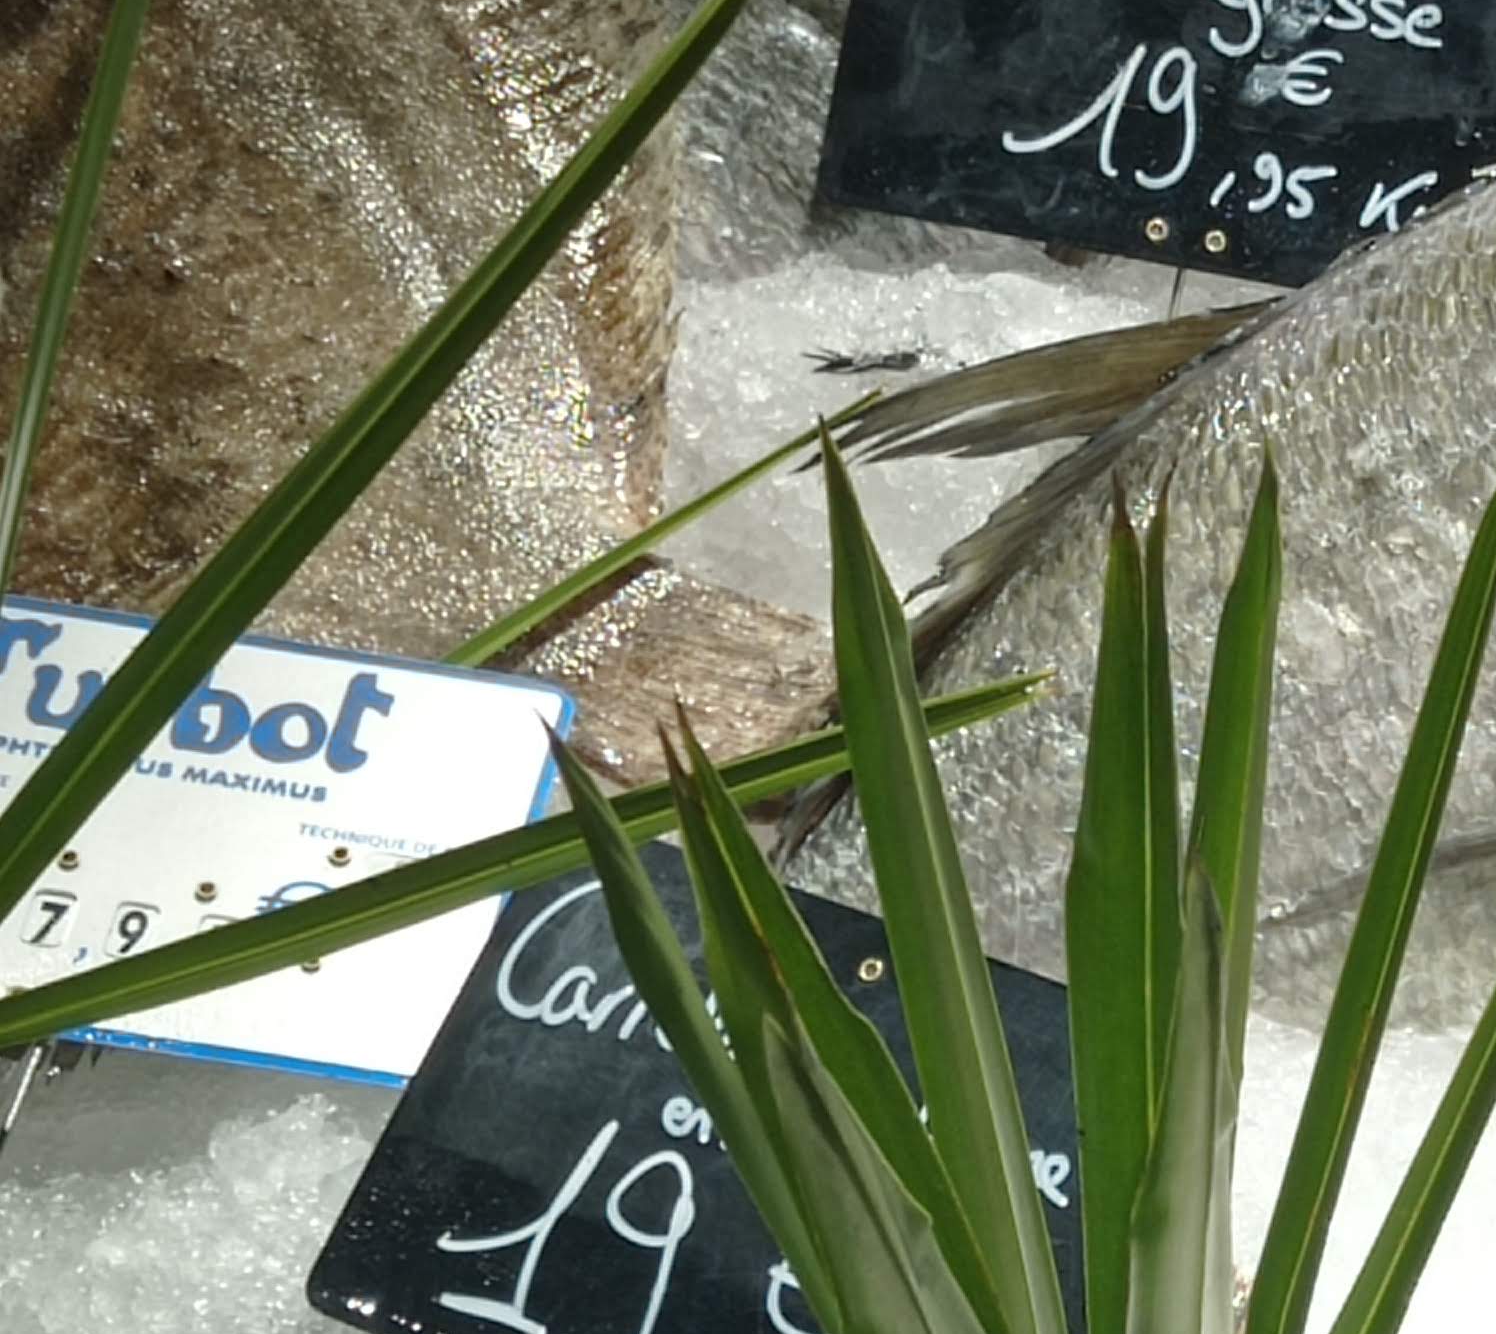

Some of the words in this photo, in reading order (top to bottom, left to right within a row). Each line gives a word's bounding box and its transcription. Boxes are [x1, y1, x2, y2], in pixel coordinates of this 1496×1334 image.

[1358, 170, 1439, 233] K
[182, 765, 328, 803] MAXIMUS
[299, 821, 407, 851] TECHNIQUE
